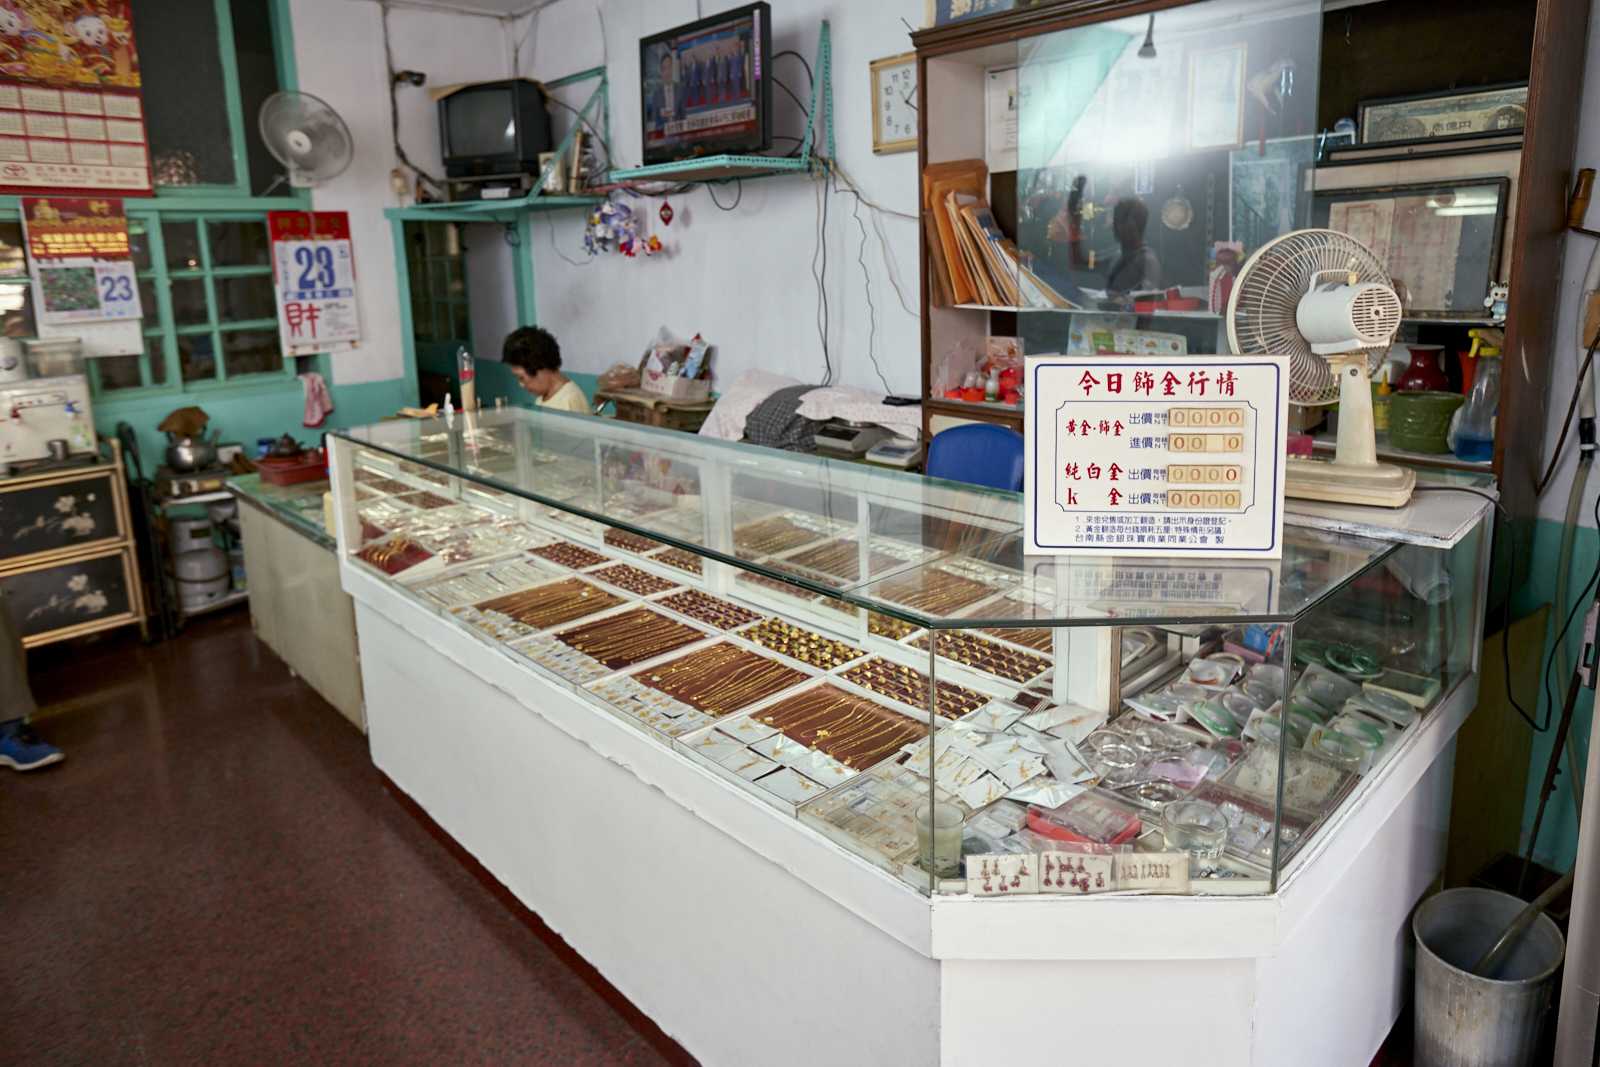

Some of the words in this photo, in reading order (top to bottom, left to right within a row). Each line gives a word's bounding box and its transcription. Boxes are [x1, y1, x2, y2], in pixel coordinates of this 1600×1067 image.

[892, 74, 899, 83] 11
[902, 69, 911, 80] 12
[884, 86, 893, 96] 10
[885, 101, 891, 111] 9
[886, 116, 892, 126] 8
[894, 124, 900, 134] 7
[904, 124, 911, 135] 6
[295, 246, 336, 290] 23
[101, 276, 133, 301] 23
[1078, 370, 1238, 396] 今日飾金行情
[1129, 412, 1153, 425] 出價
[1129, 437, 1153, 449] 進價
[1065, 461, 1124, 481] 純白金
[1128, 468, 1152, 481] 出價
[1128, 492, 1152, 505] 出價
[1215, 535, 1225, 544] 製
